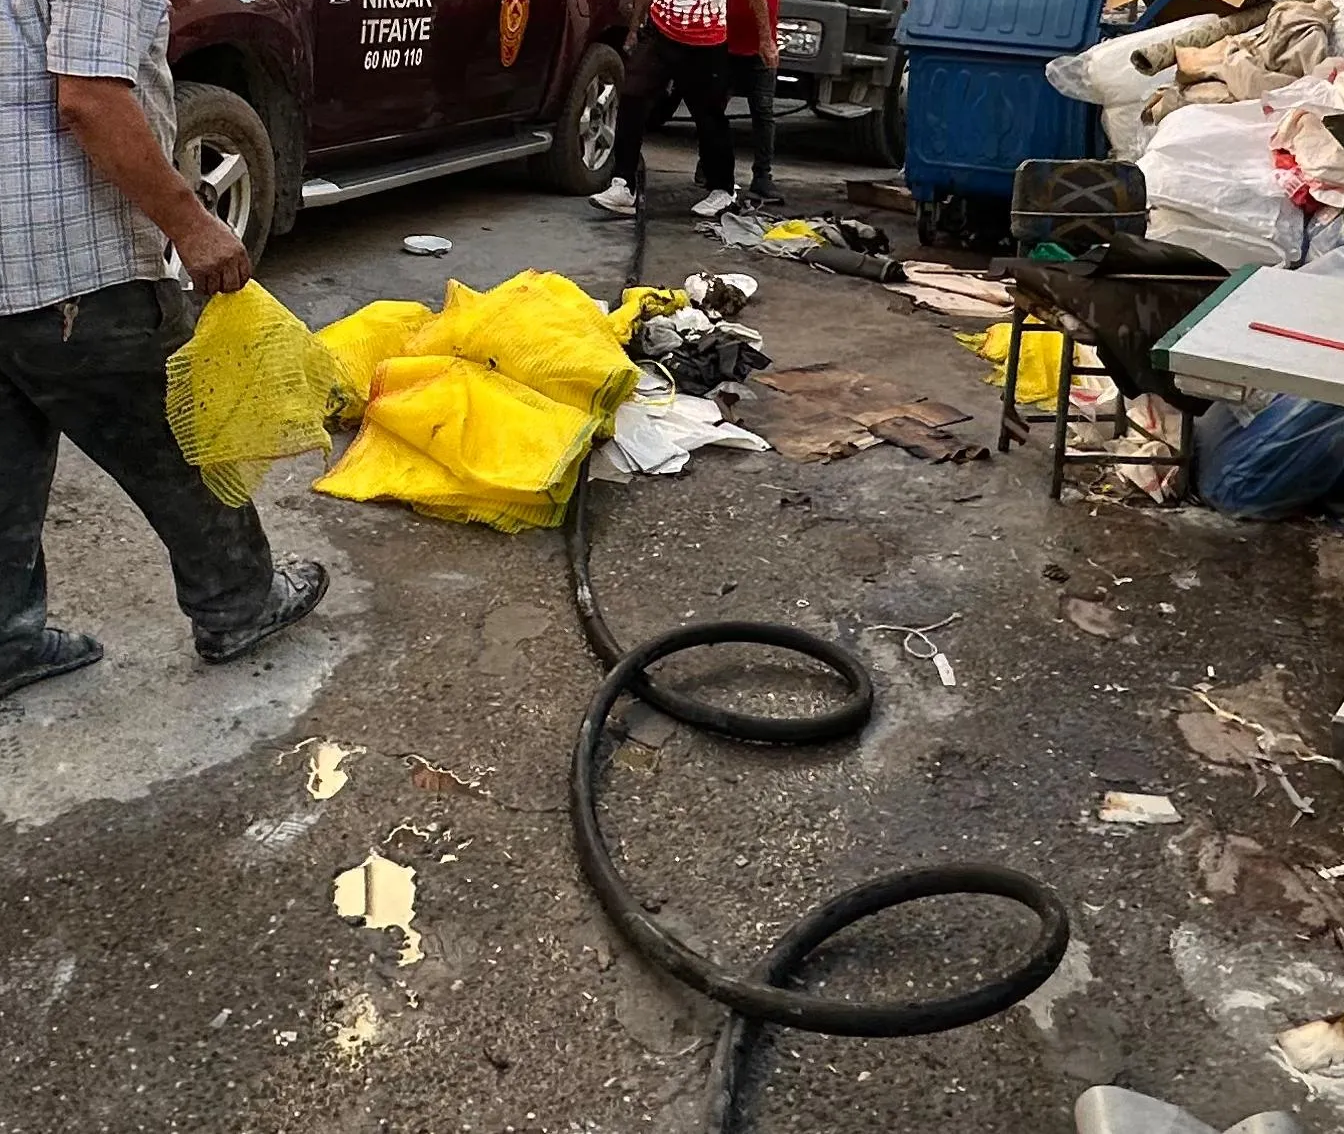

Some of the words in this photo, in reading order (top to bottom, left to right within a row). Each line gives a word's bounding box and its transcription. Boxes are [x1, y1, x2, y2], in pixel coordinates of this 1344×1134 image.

[364, 50, 379, 70] 60
[382, 49, 400, 68] ND
[404, 47, 423, 66] 110
